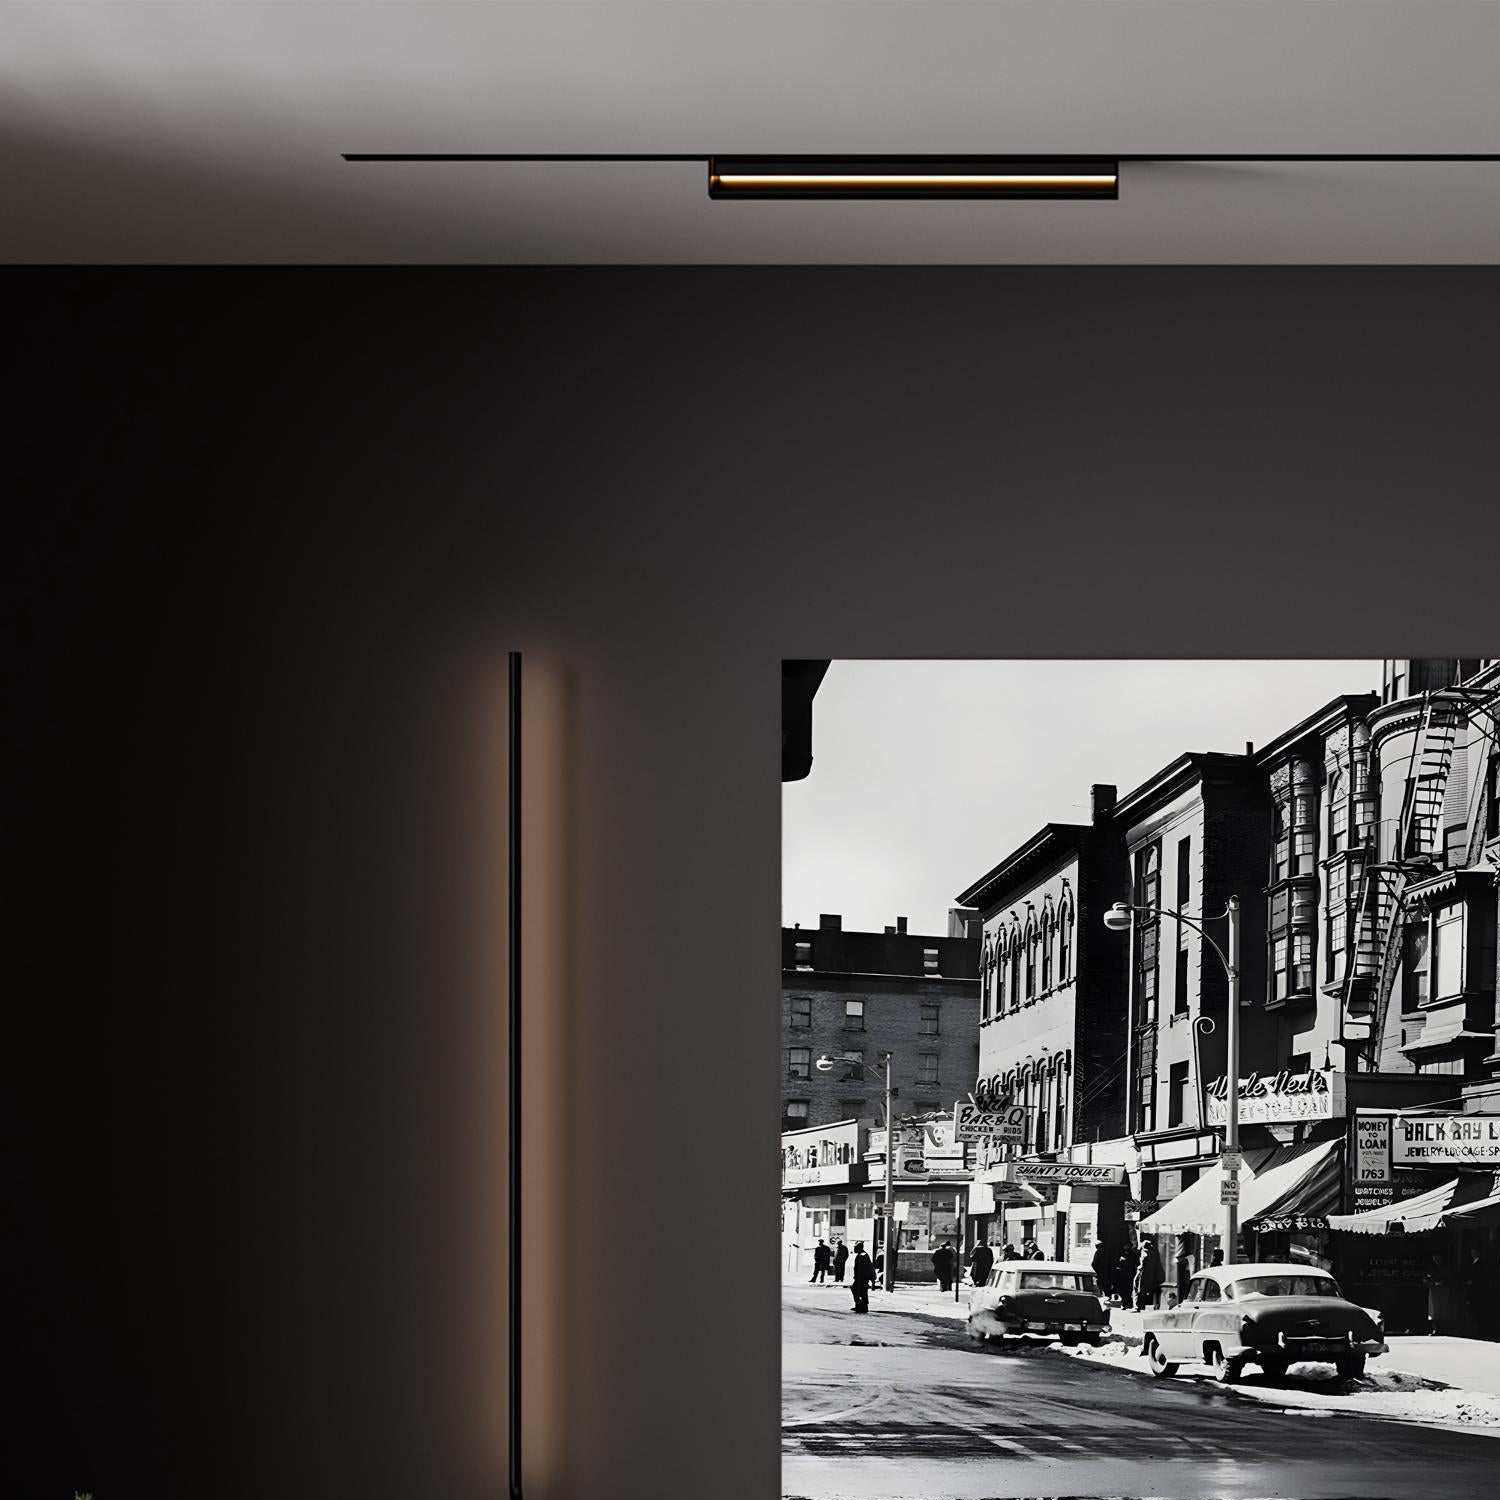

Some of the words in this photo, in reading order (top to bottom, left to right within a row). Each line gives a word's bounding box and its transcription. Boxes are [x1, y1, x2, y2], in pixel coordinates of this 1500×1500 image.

[1206, 1072, 1267, 1098] Ucle
[960, 1106, 1024, 1126] BAR-B-Q
[1358, 1121, 1388, 1132] MONEY
[1404, 1122, 1446, 1142] BACK
[1359, 1138, 1387, 1150] LOAN
[1015, 1165, 1062, 1176] SHANTY
[1065, 1167, 1112, 1178] LOUNGE
[1361, 1169, 1385, 1179] 1763
[1223, 1181, 1238, 1189] NO
